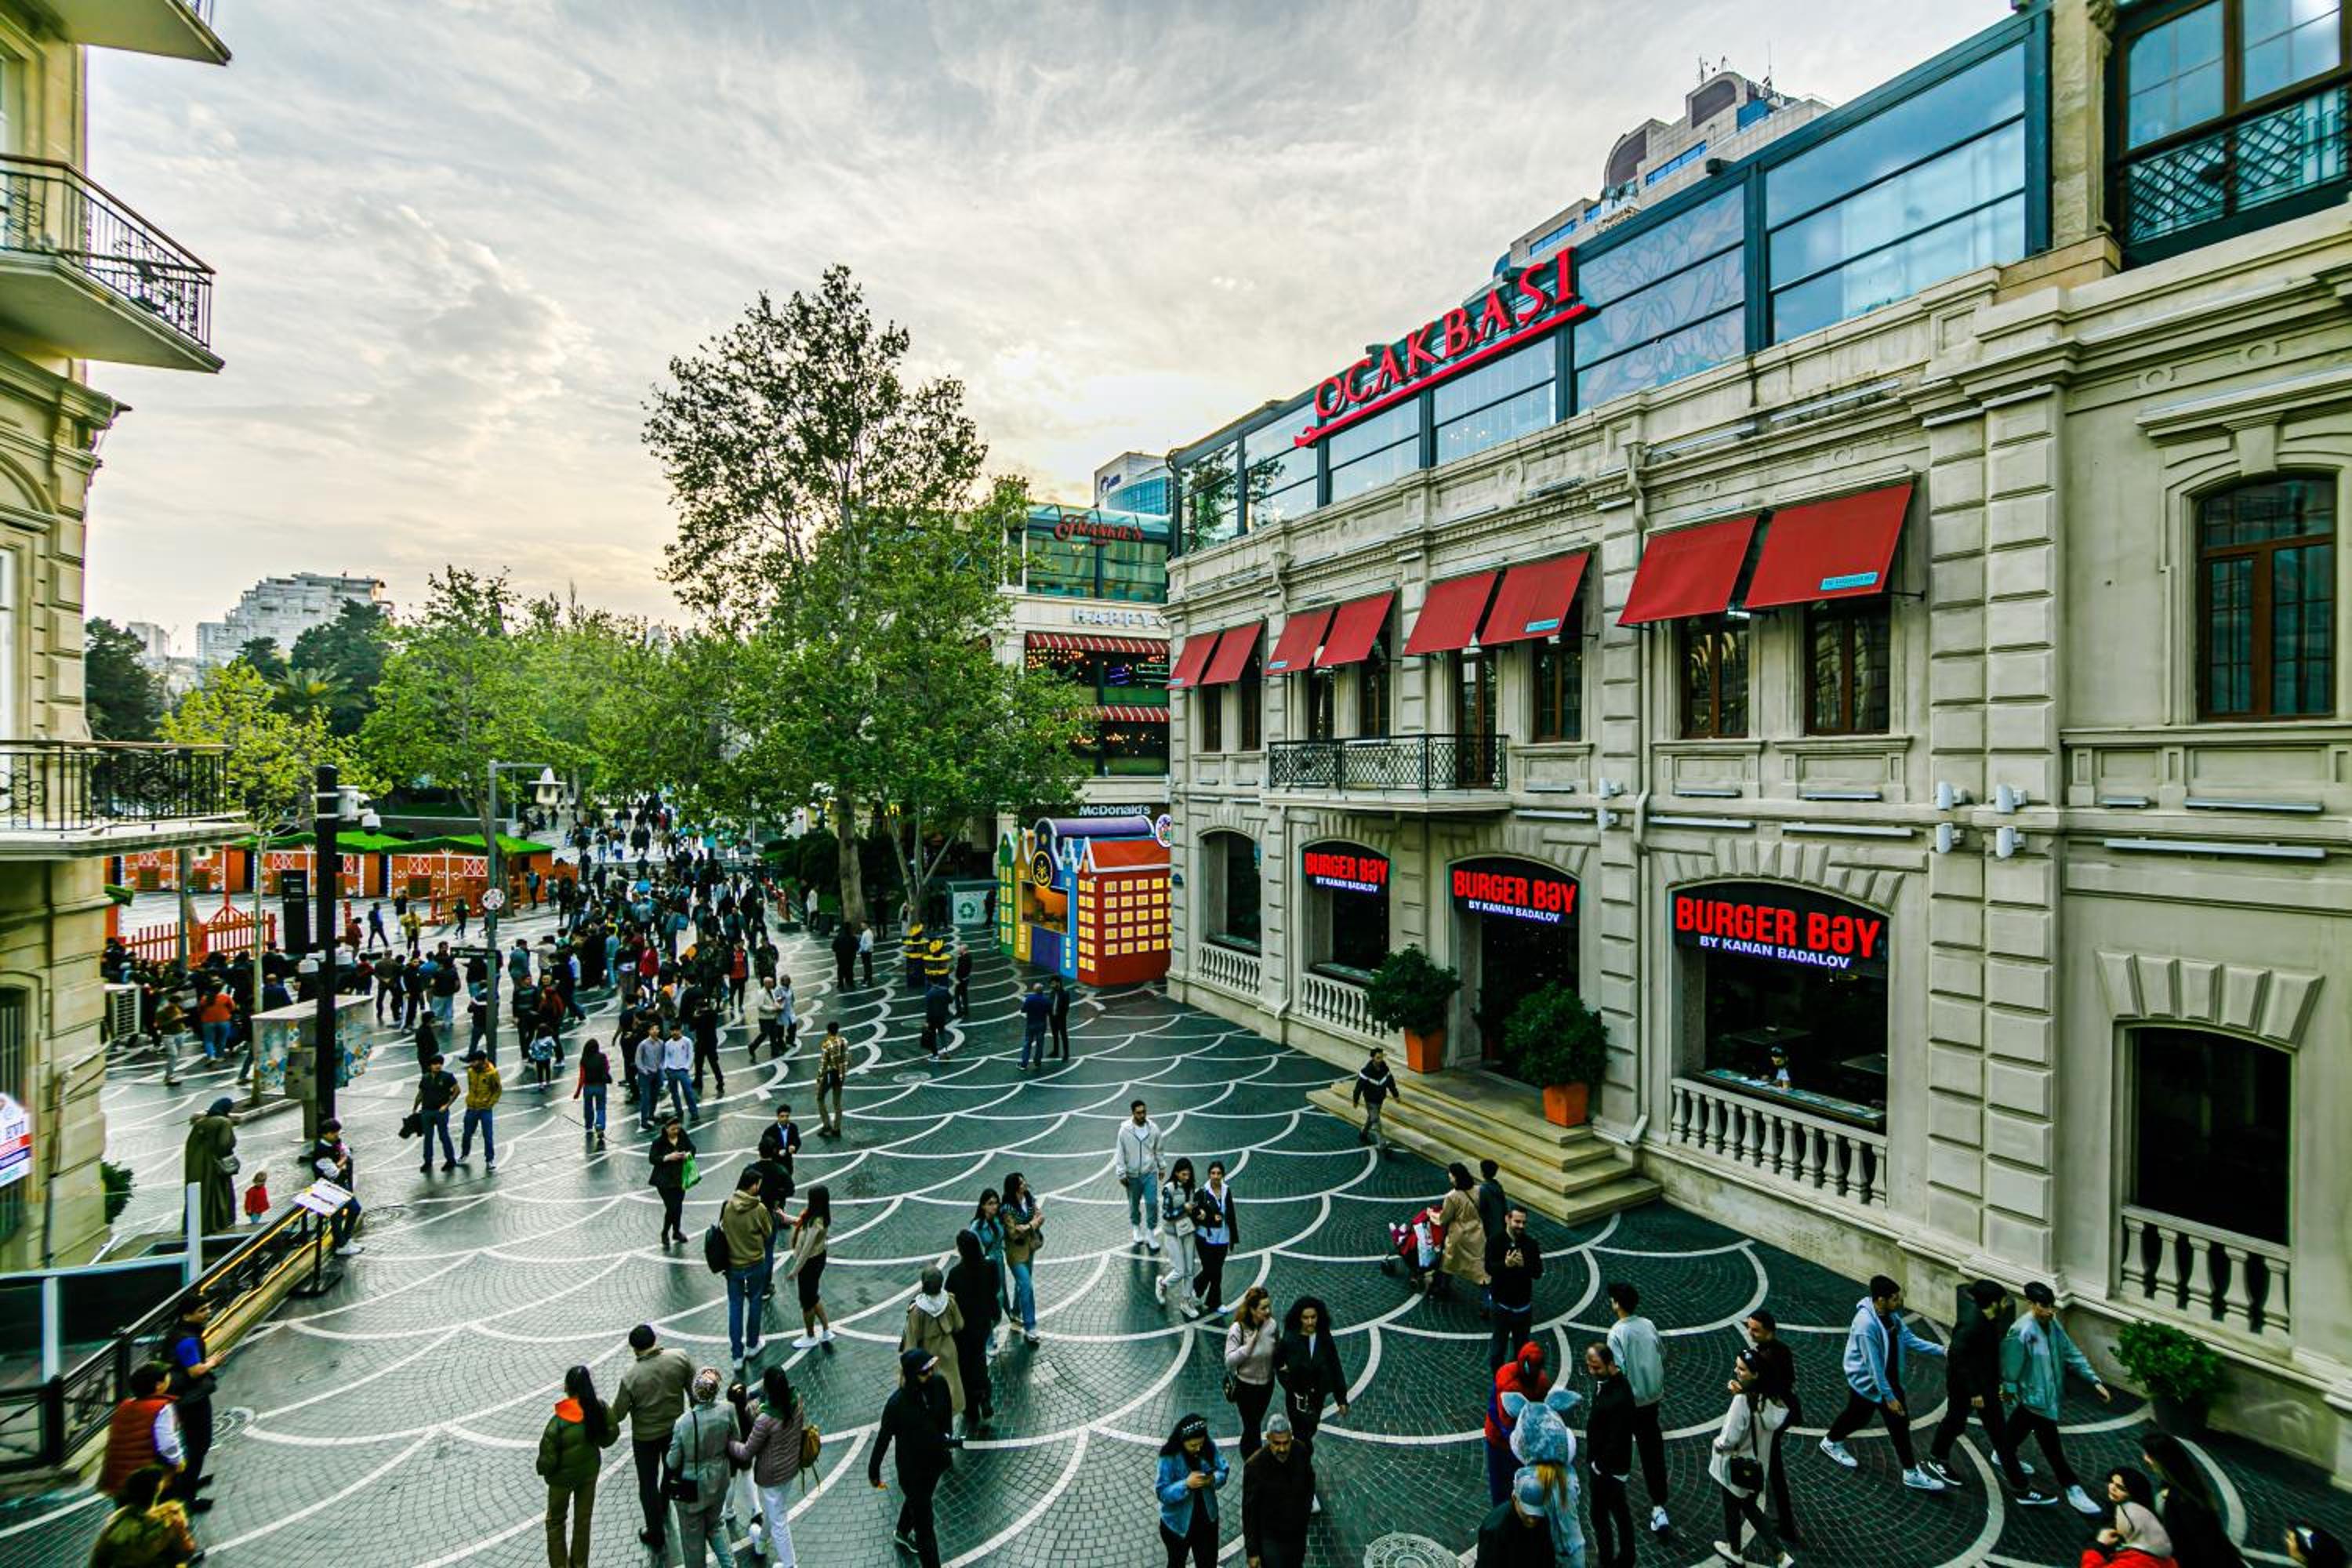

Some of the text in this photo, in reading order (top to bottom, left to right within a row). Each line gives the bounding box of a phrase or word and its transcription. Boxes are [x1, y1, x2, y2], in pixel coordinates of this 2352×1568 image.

[1079, 804, 1152, 815] McDonald's
[1305, 852, 1356, 879] BURGER
[1316, 876, 1325, 884] BY
[1454, 870, 1528, 906] BURGER
[1468, 899, 1559, 923] BY KANAN BADALOV
[1675, 896, 1797, 946] BURGER
[1700, 935, 1849, 968] BY KANAN BADALOV
